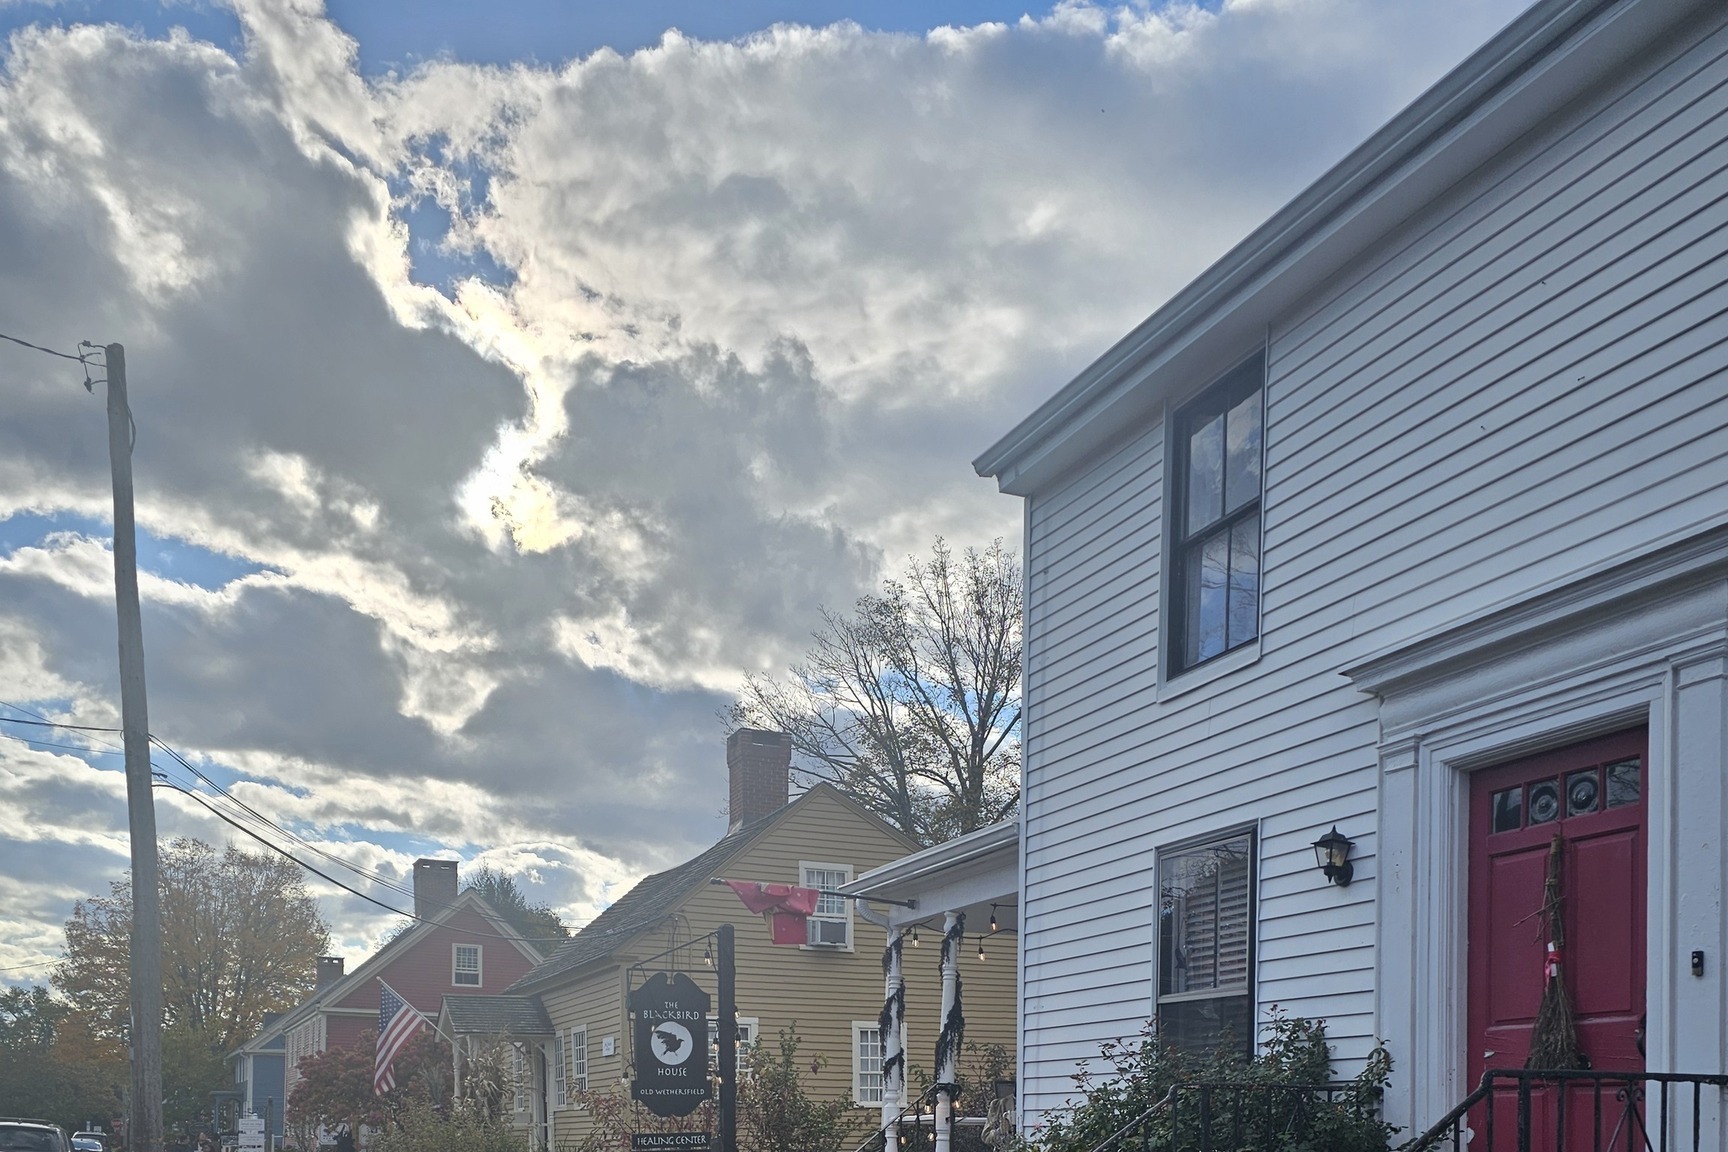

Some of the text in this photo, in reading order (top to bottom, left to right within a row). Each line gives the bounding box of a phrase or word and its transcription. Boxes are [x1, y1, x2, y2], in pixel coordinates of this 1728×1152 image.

[664, 1001, 678, 1009] THE
[643, 1010, 699, 1020] BLACKBIRD
[657, 1067, 687, 1077] HOUSE
[655, 1088, 705, 1096] WETHERSFIELD
[637, 1135, 707, 1145] HEALING CENTER
